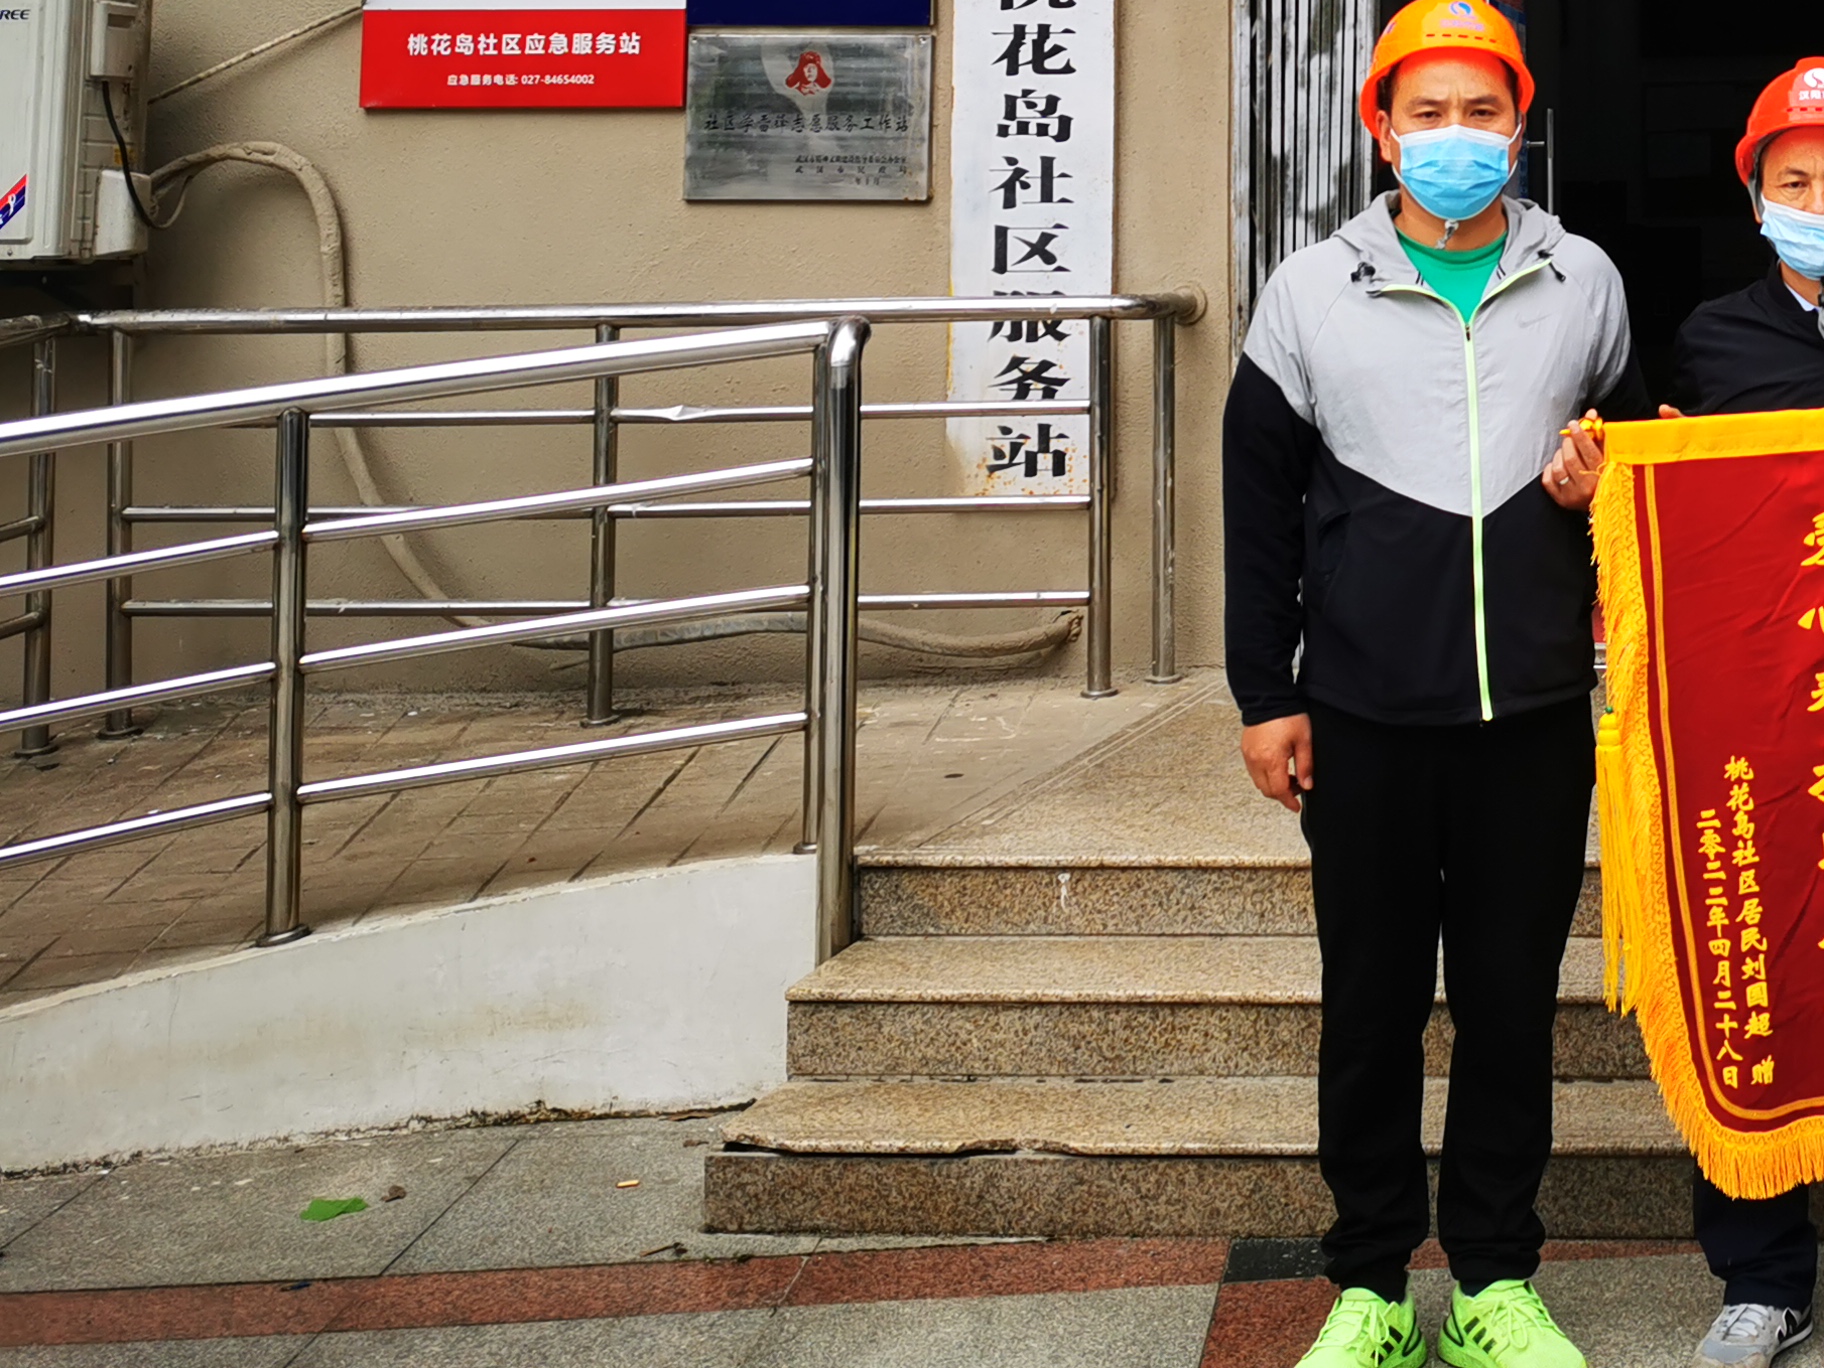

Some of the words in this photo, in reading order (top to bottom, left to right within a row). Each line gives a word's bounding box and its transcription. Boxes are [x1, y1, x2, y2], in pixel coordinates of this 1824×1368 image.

[407, 31, 642, 56] 桃花岛社区应急服务站
[520, 74, 596, 85] 027-84654002
[1696, 808, 1744, 1090] 二零二二年四月二十八日
[1723, 755, 1774, 1041] 桃花岛社区居民刘国超
